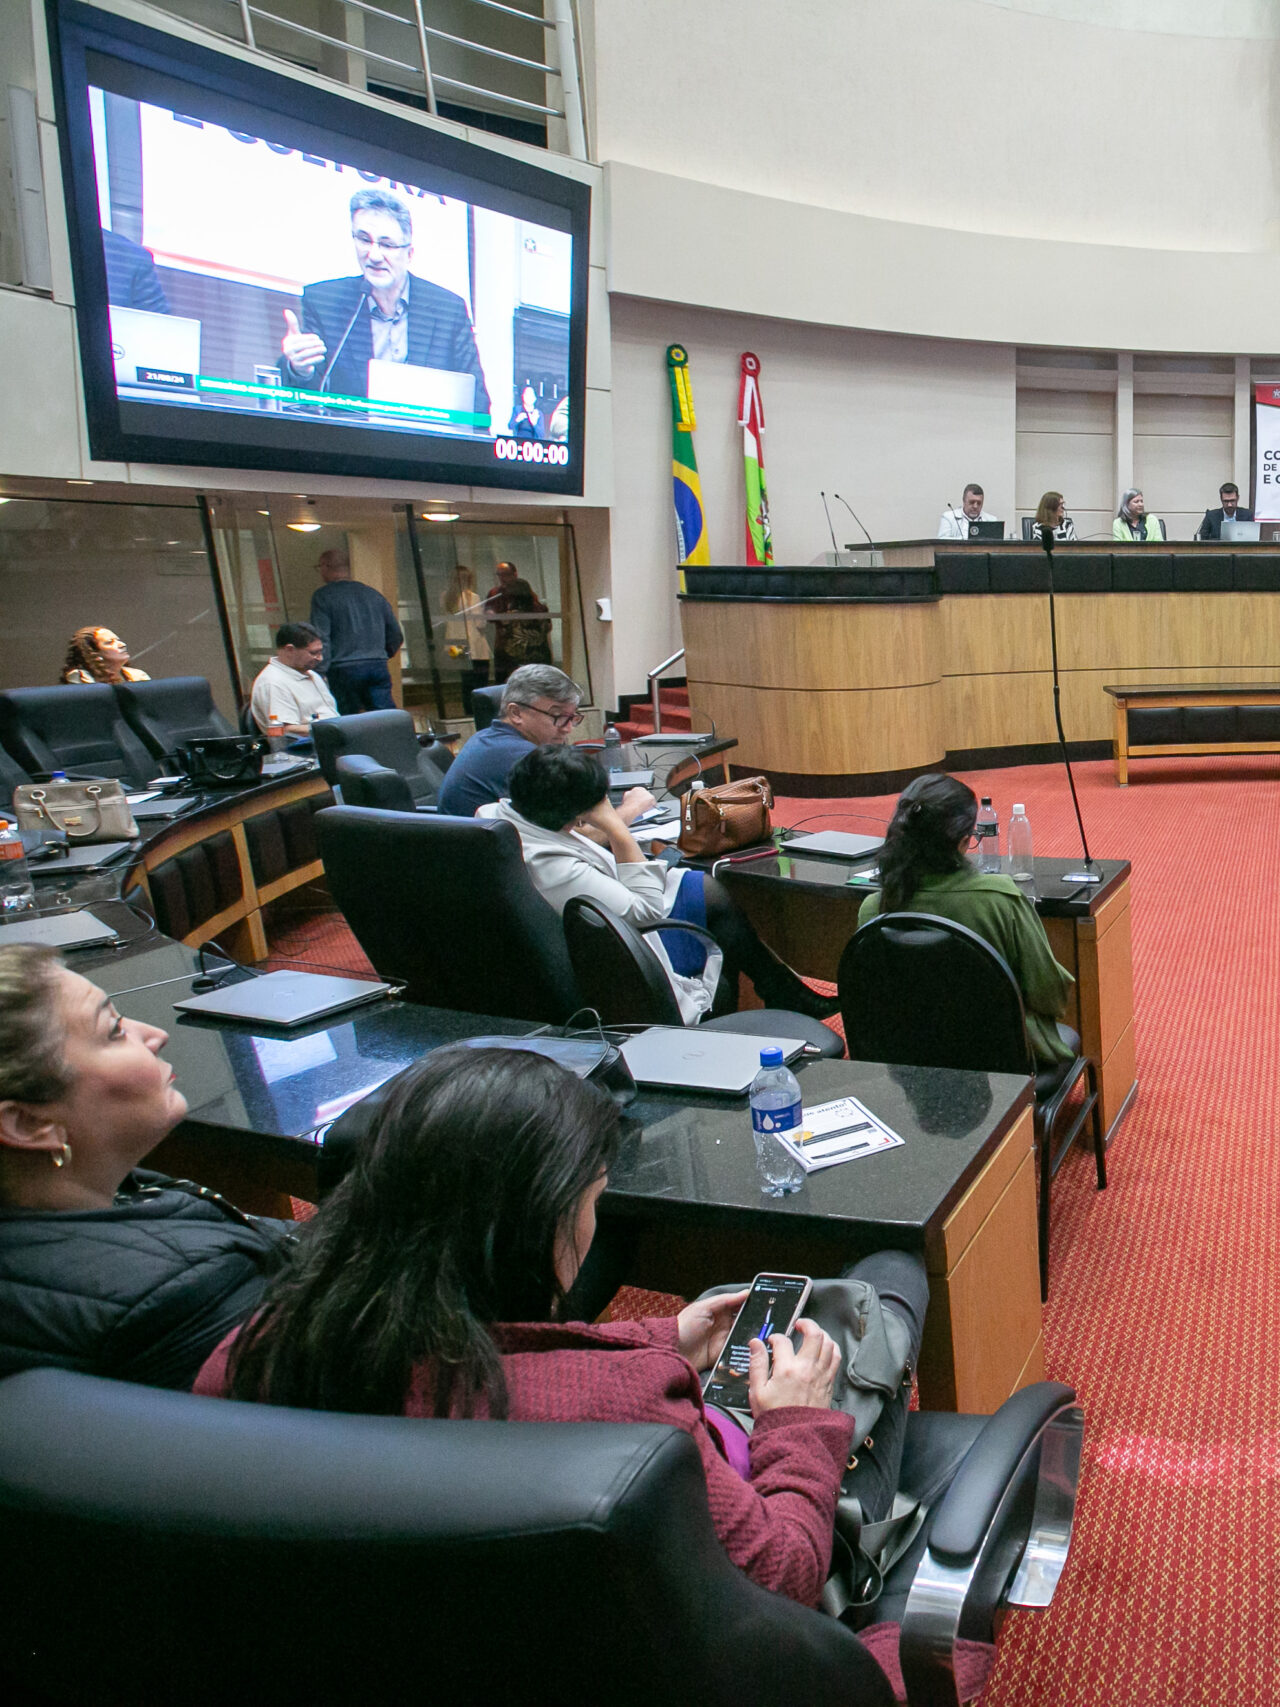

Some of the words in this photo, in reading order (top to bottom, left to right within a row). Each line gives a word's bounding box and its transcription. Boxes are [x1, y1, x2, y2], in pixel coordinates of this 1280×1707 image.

[495, 438, 569, 466] 00:00:00
[1263, 463, 1277, 472] DE
[1263, 474, 1271, 484] E
